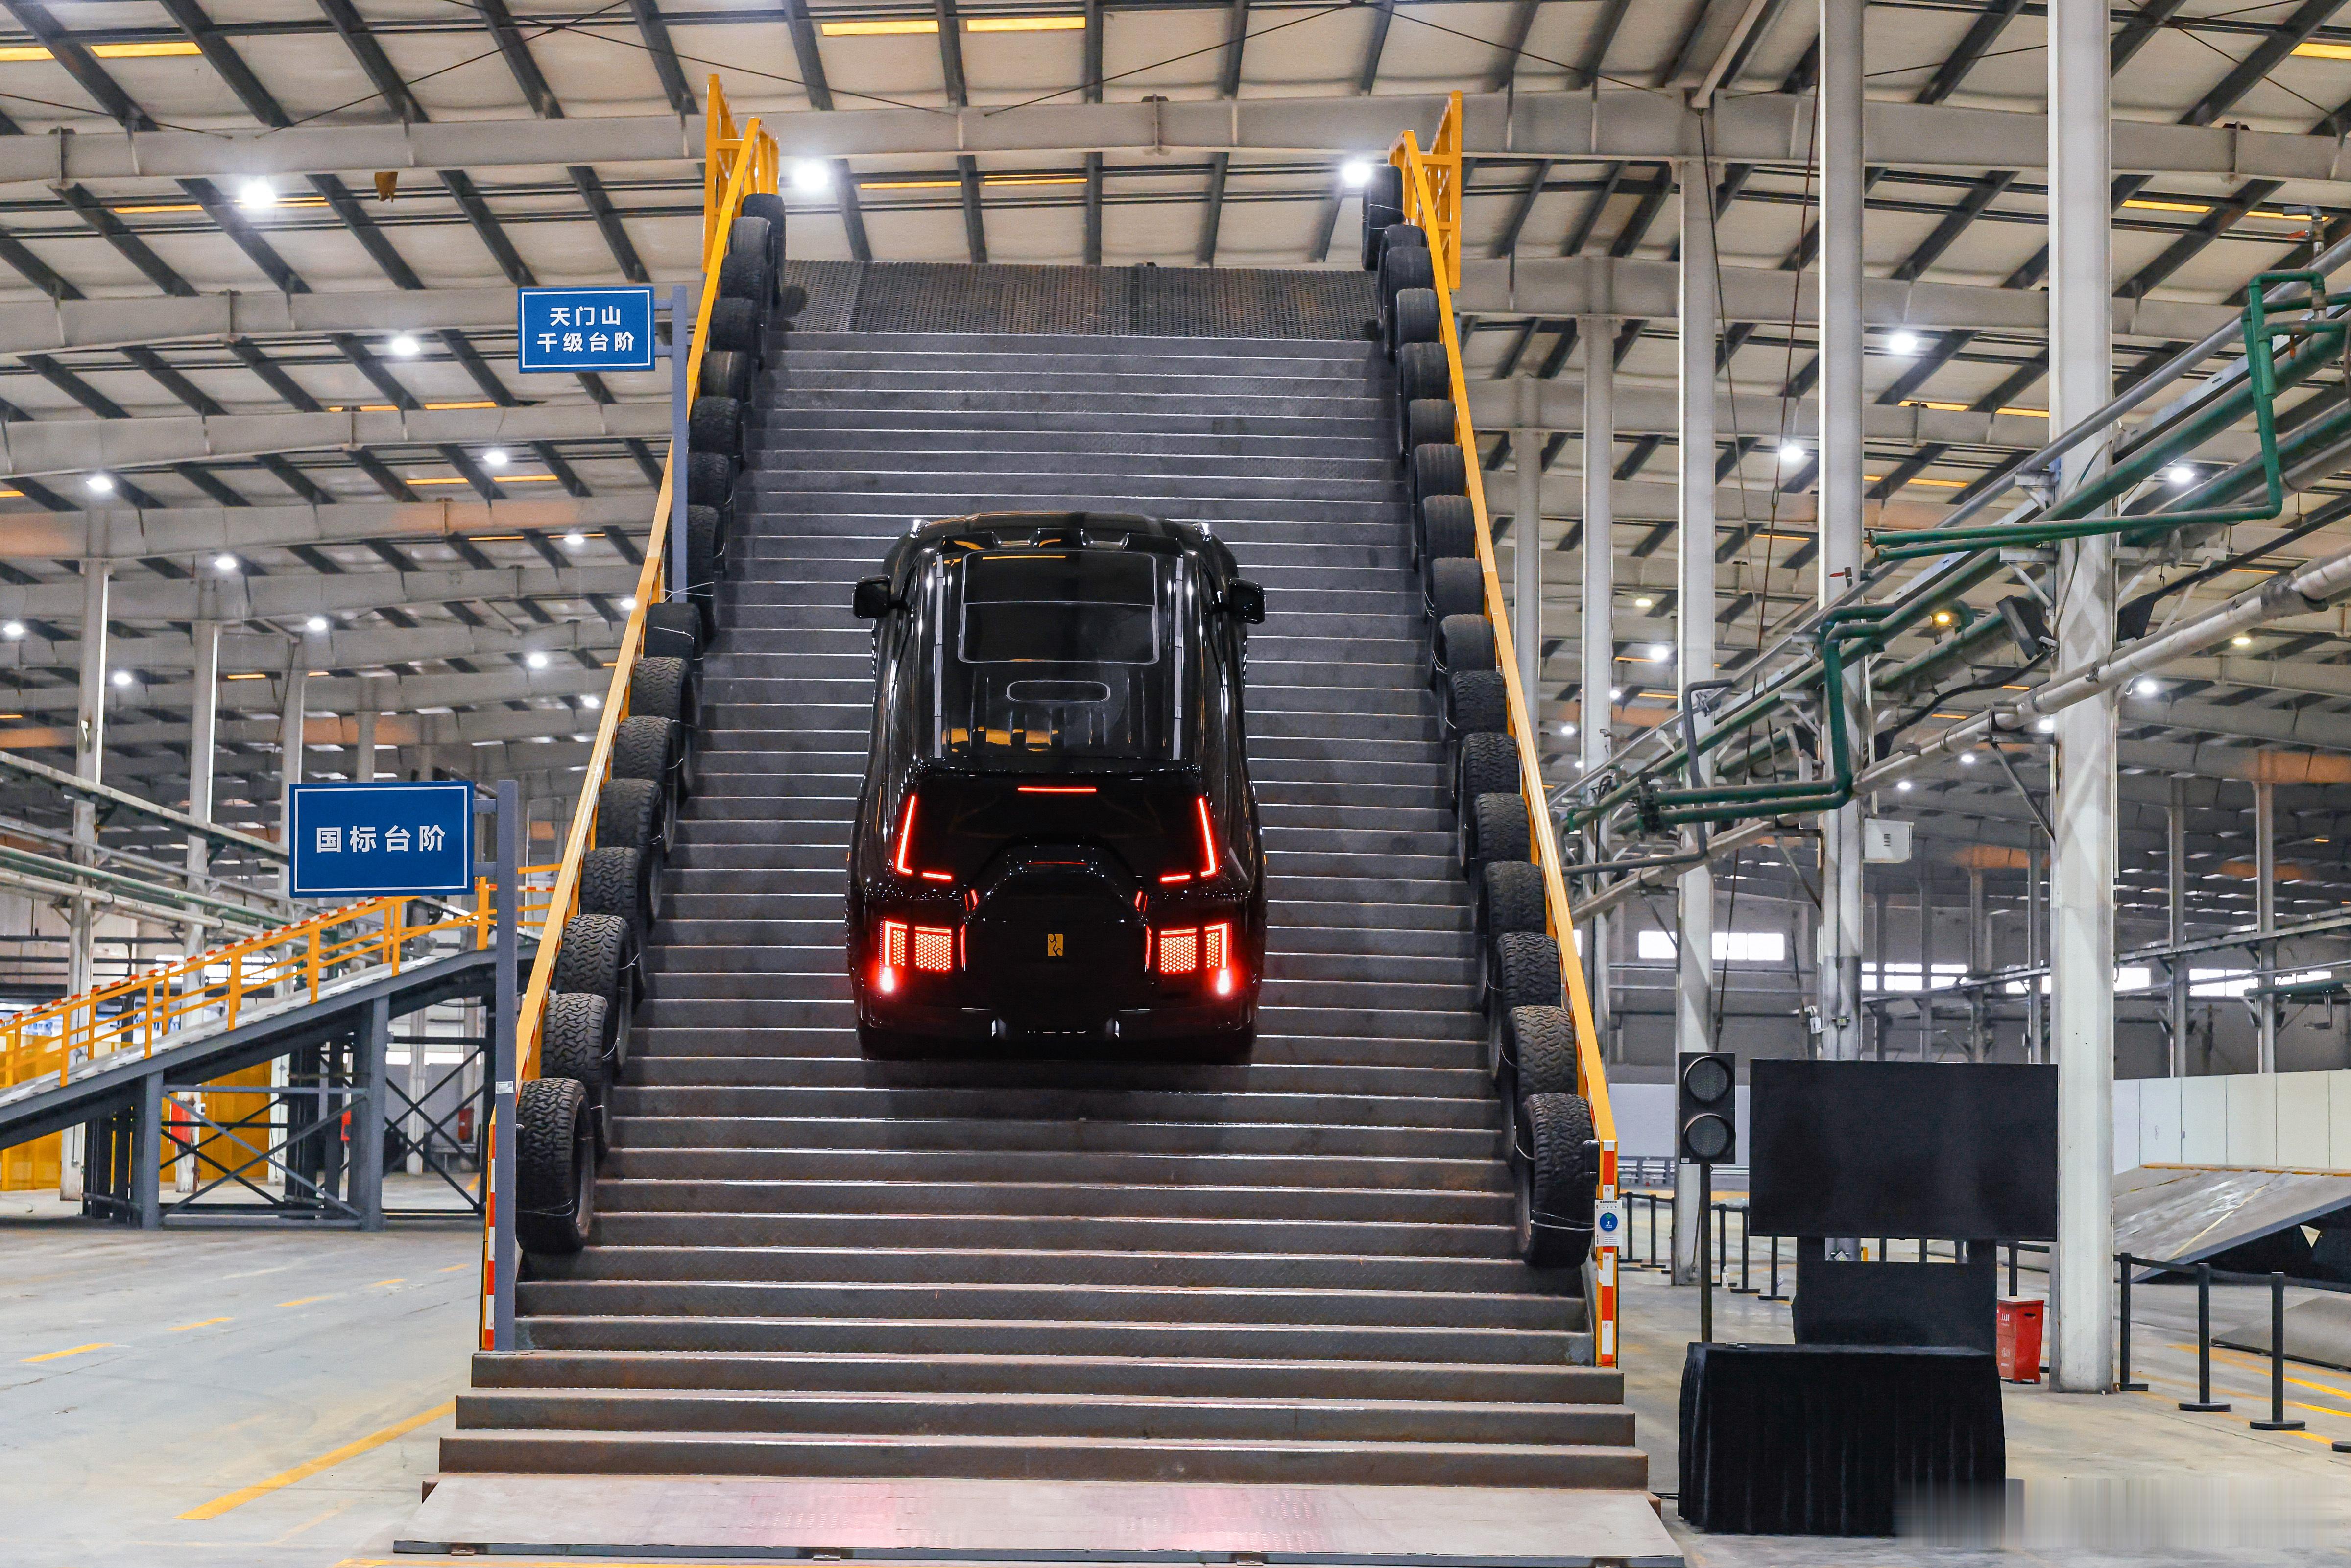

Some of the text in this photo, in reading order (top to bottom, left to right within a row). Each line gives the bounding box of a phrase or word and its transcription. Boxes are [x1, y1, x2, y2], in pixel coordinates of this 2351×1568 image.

[550, 306, 621, 327] 天门山
[316, 825, 445, 853] 国标台阶
